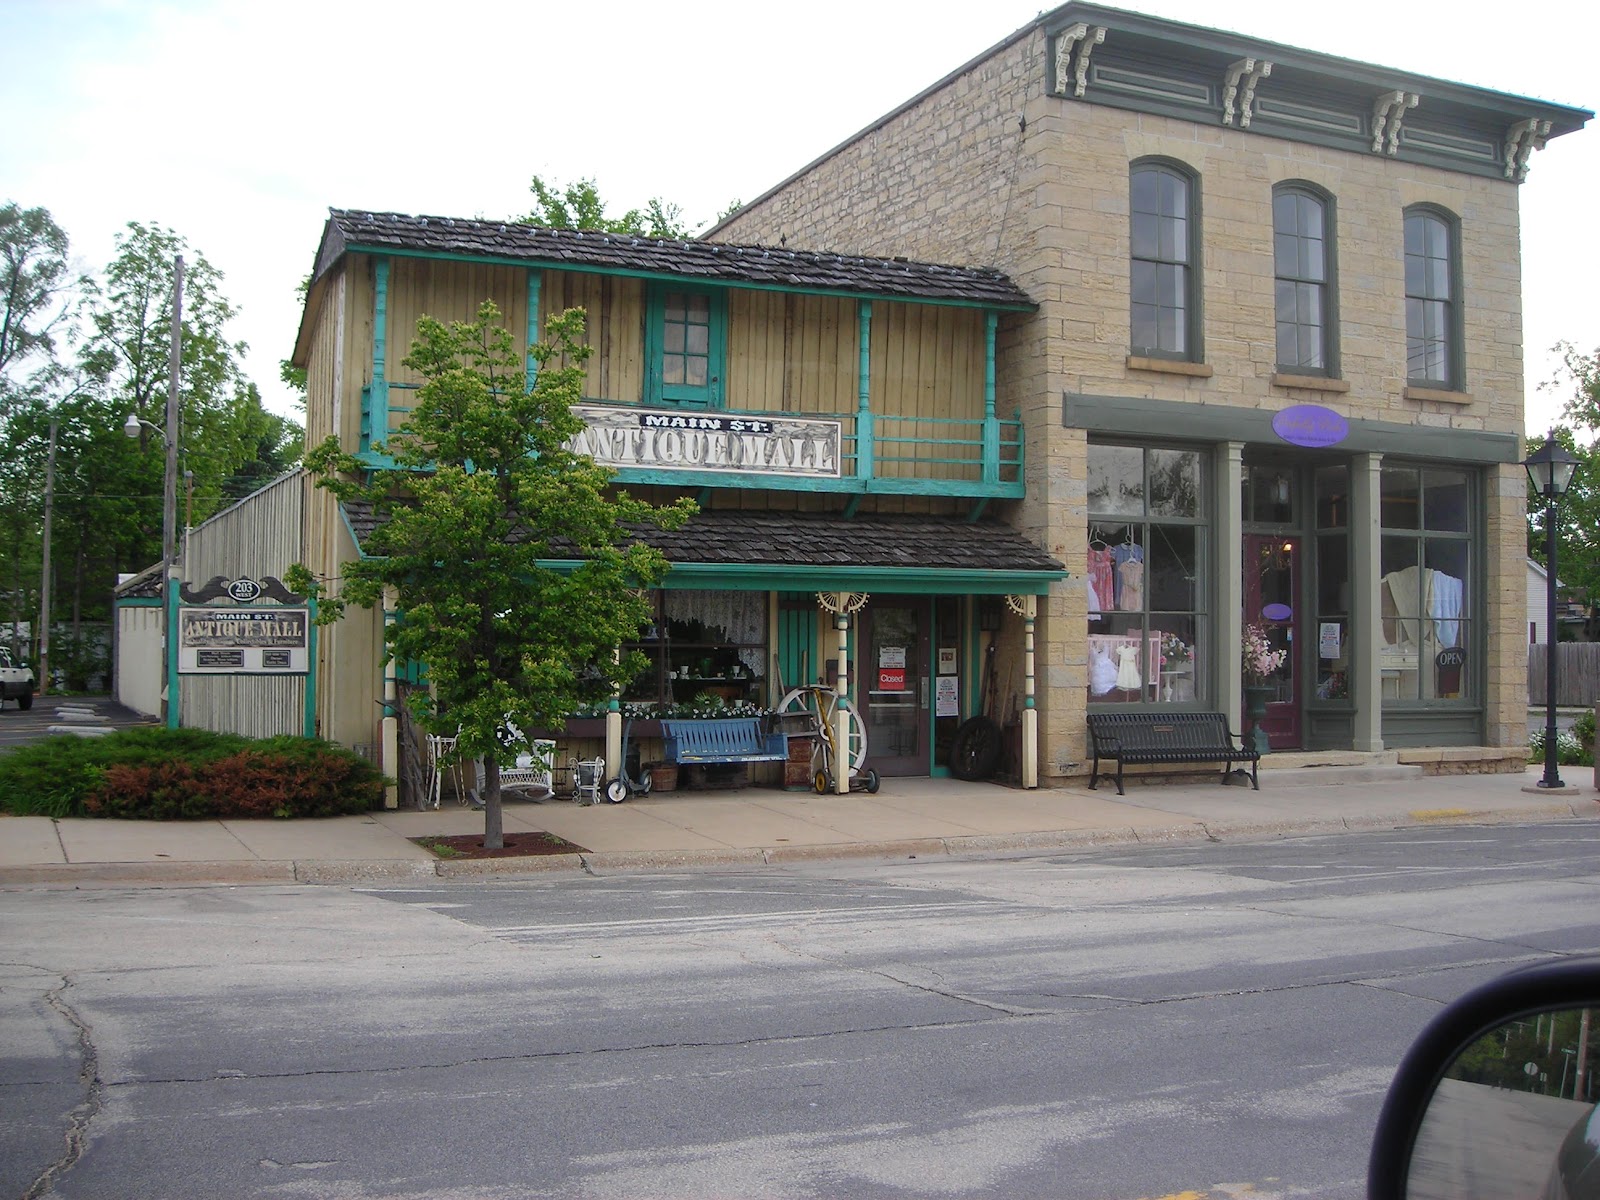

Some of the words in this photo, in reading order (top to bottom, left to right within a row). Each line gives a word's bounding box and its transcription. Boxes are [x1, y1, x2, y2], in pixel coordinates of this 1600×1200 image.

[645, 414, 722, 430] MAIN
[573, 427, 727, 464] ANTIQUE
[742, 433, 834, 469] MALL
[235, 582, 253, 593] 203
[186, 621, 253, 637] ANTIQUE
[260, 621, 302, 637] MALL
[1439, 652, 1463, 666] OPEN
[880, 674, 904, 683] Closed
